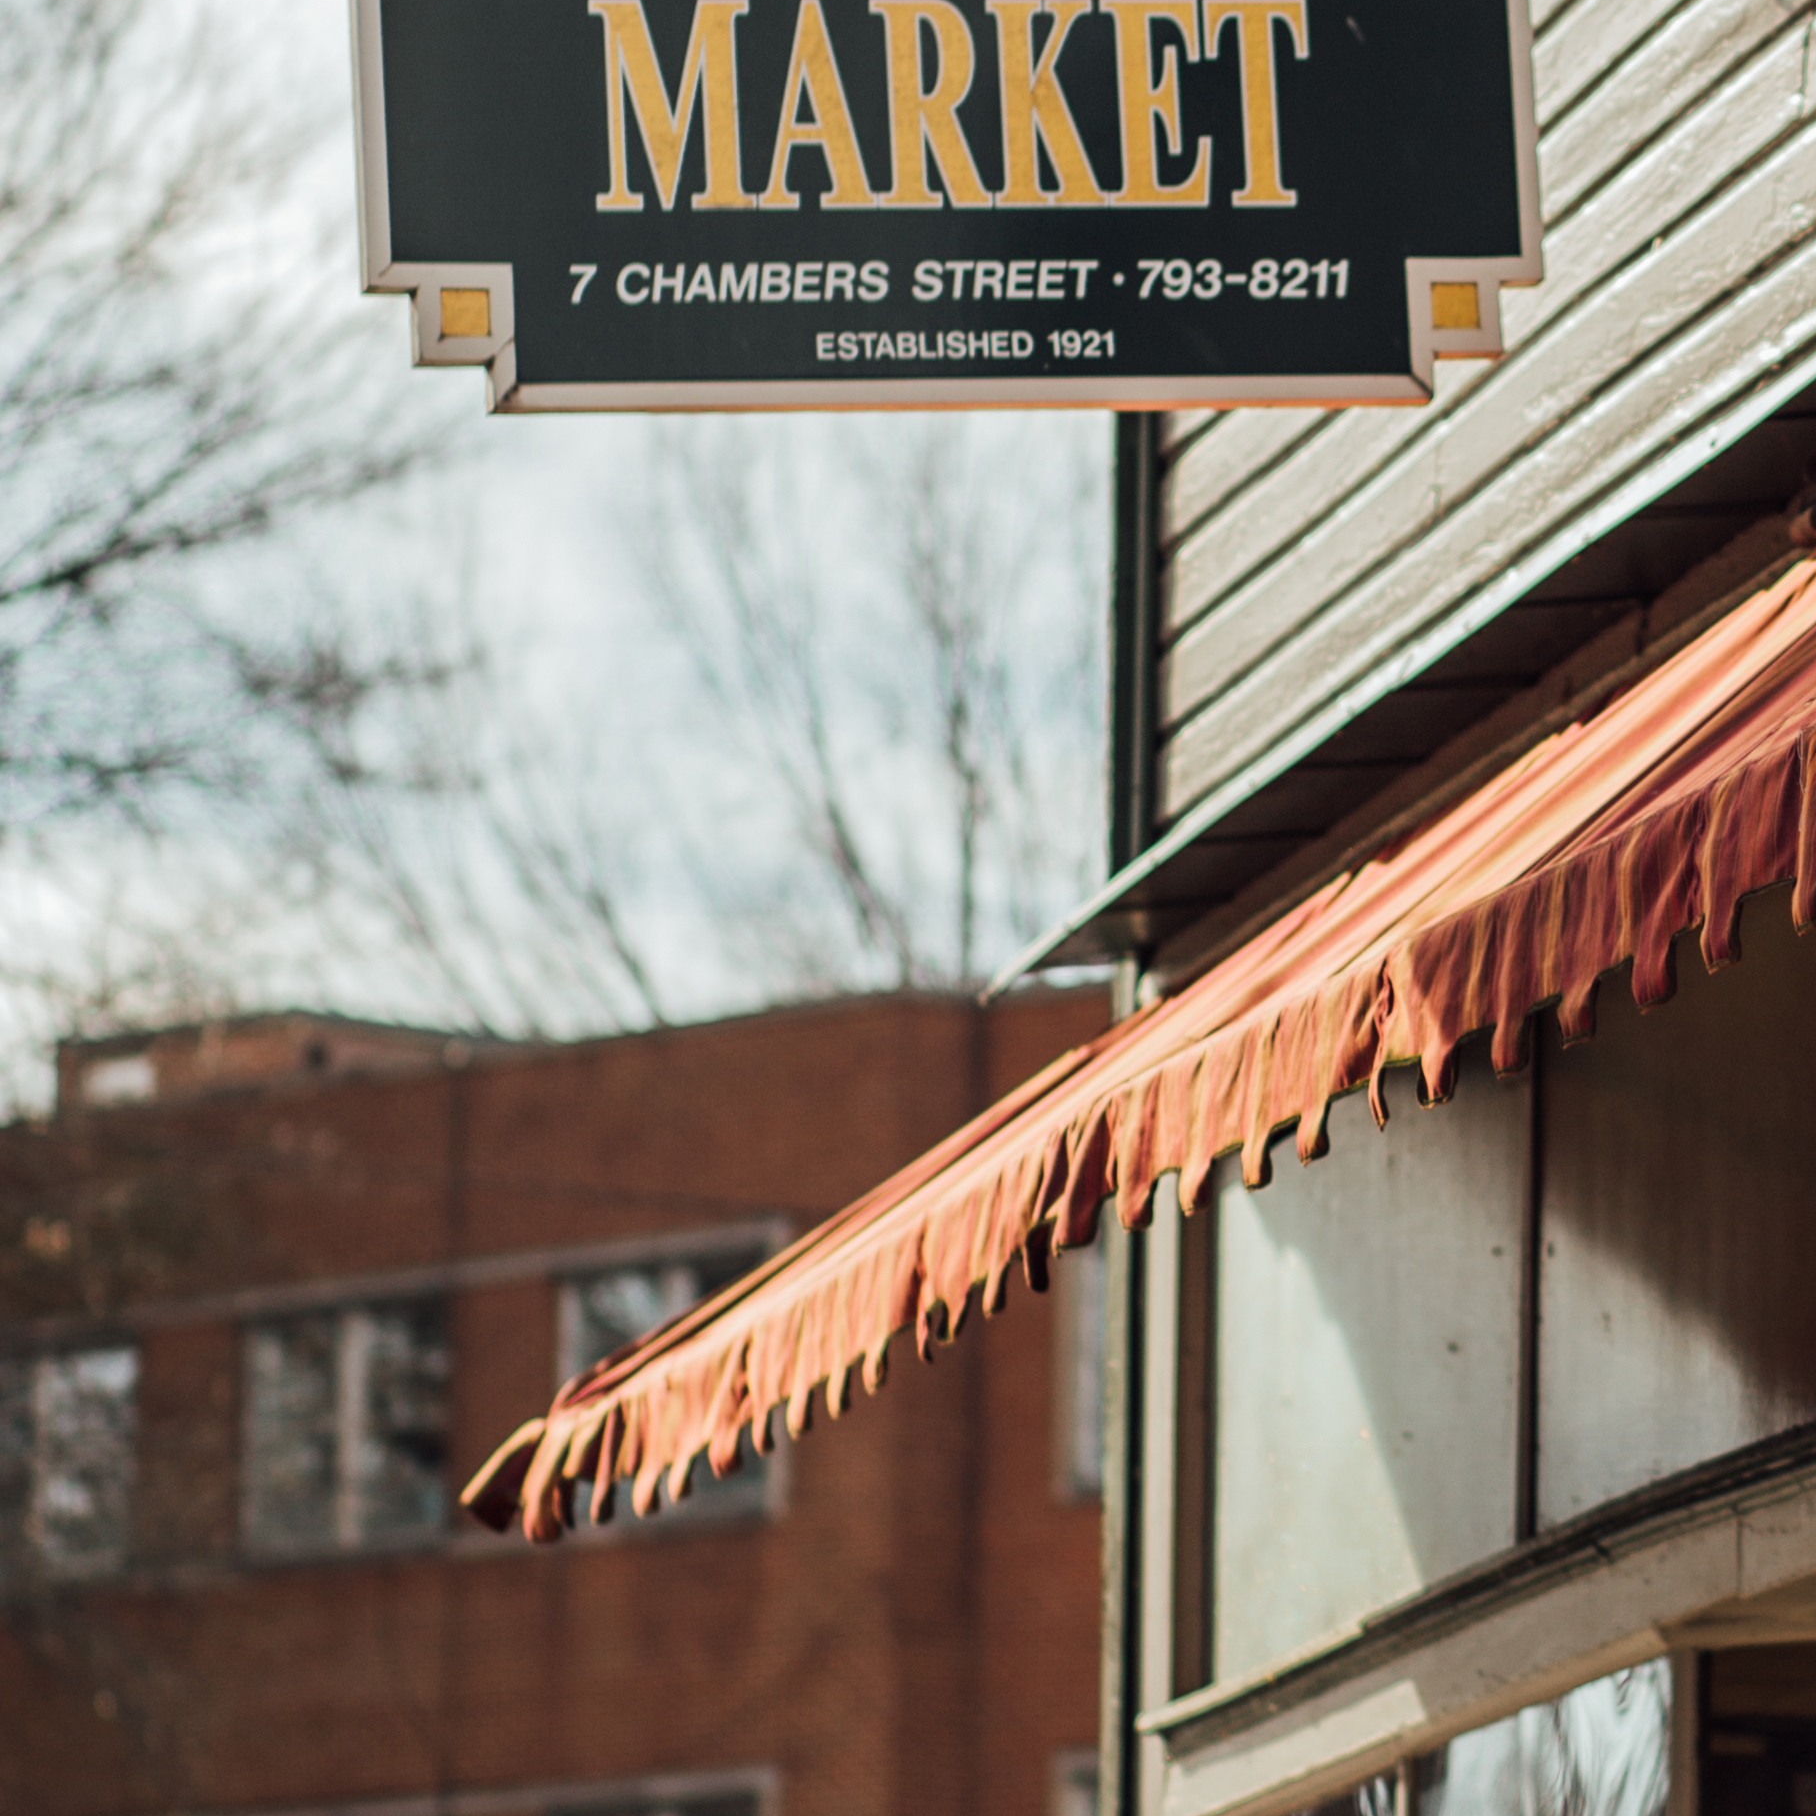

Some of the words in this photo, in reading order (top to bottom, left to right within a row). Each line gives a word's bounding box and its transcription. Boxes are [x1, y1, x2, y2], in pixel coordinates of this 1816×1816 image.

[567, 264, 596, 304] 7
[615, 262, 890, 303] CHAMBERS
[912, 260, 1099, 302] STREET
[1136, 259, 1351, 300] 793-8211
[815, 331, 1035, 361] ESTABLISHED
[1046, 330, 1117, 359] 1921
